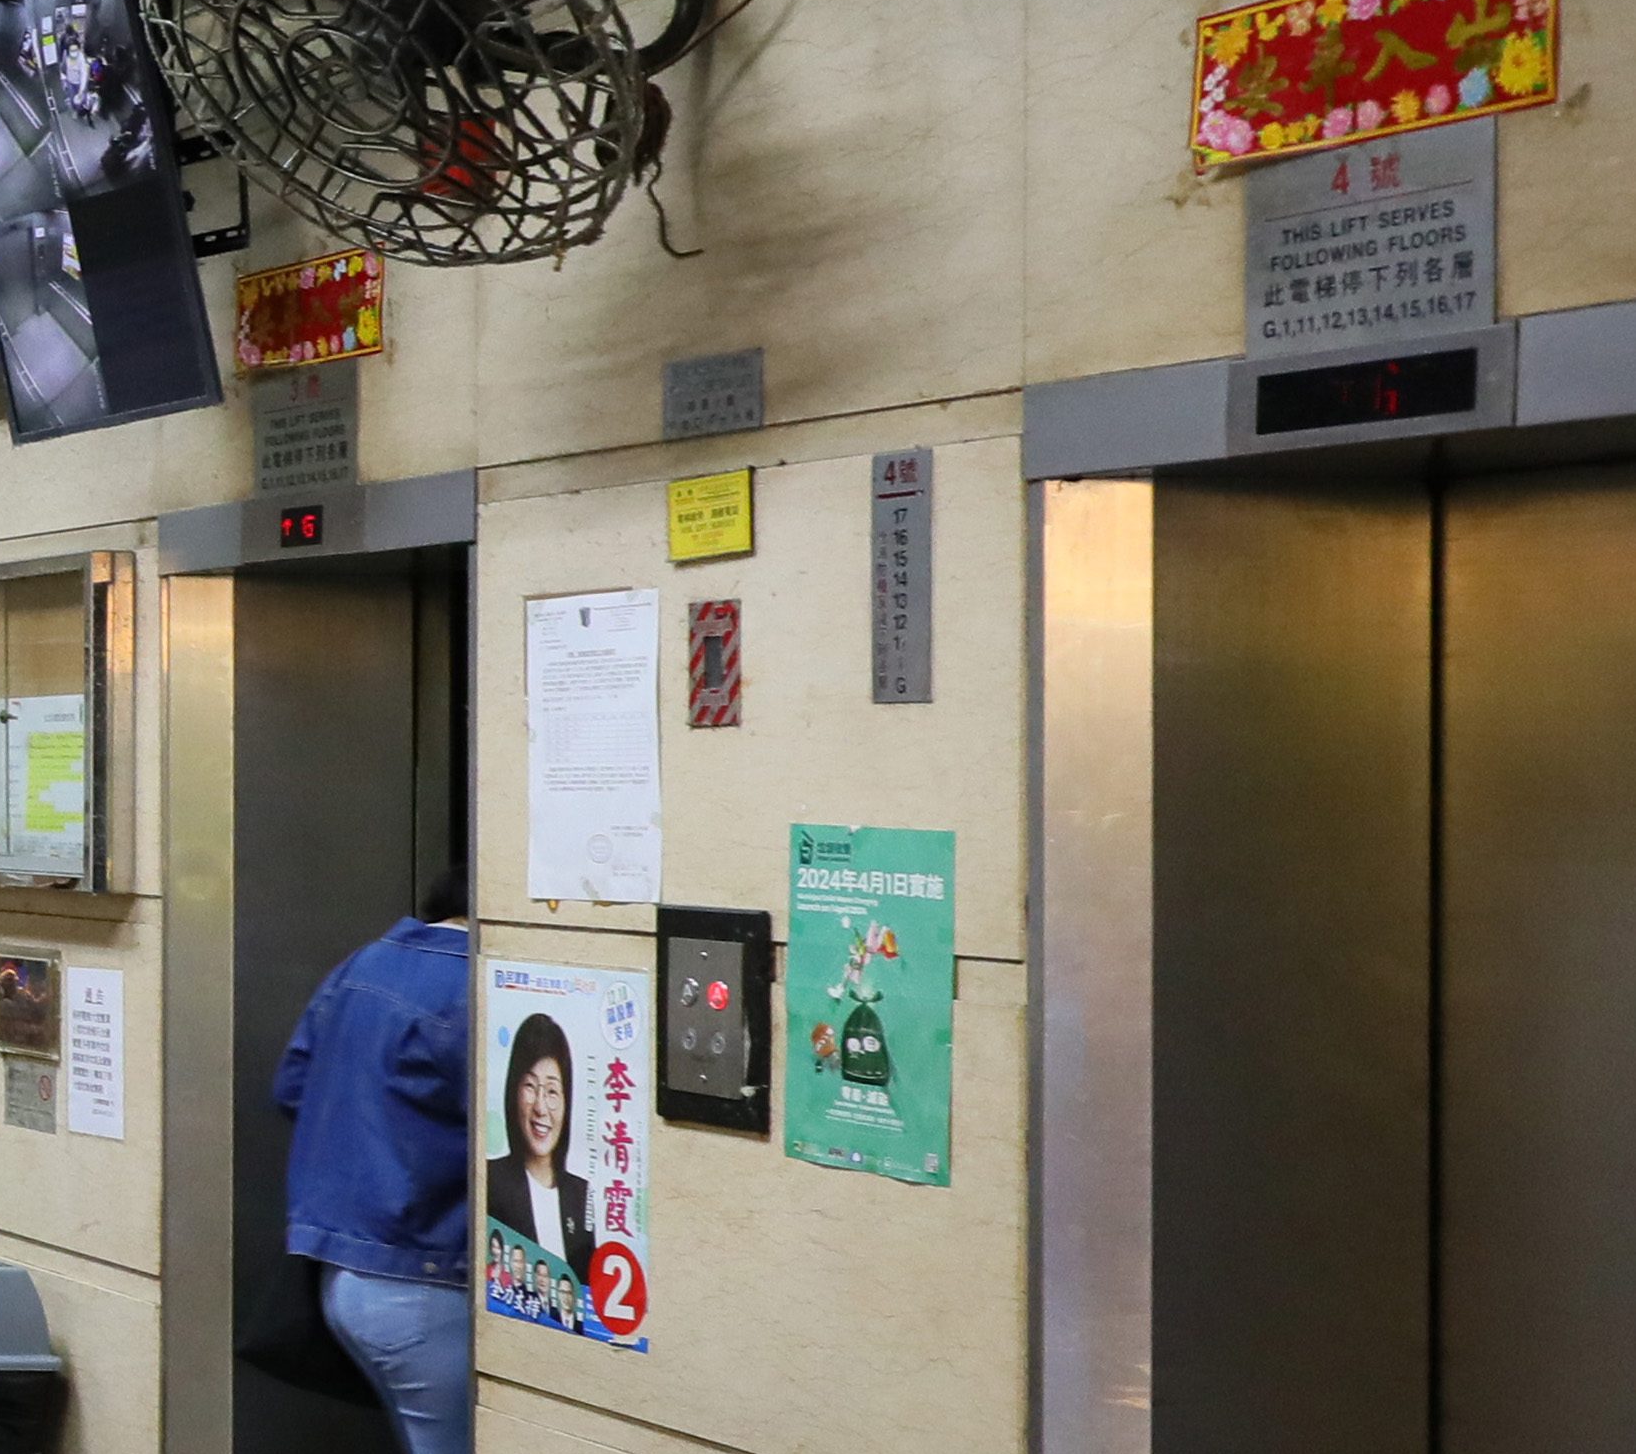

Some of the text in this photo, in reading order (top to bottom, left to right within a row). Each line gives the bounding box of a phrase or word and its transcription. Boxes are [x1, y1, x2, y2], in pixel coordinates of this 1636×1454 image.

[1331, 161, 1350, 195] 4
[1282, 199, 1456, 247] THIS LIFT SERVES
[1269, 224, 1467, 274] FOLLOWING FLOORS
[1263, 249, 1475, 309] 此電梯停下列各層
[1262, 291, 1477, 340] G,1,11,12,13,14,15,16,17
[264, 430, 310, 446] FOLLOWING
[883, 458, 918, 485] 4號
[893, 508, 908, 524] 17
[893, 529, 908, 546] 16
[893, 551, 908, 567] 15
[893, 571, 908, 587] 14
[893, 592, 908, 610] 13
[893, 614, 908, 630] 12
[895, 677, 907, 695] G
[797, 867, 944, 900] 2024年4月1日實施
[602, 1056, 637, 1237] 李清霞
[490, 1279, 540, 1319] 全力支持
[603, 1254, 635, 1321] 2
